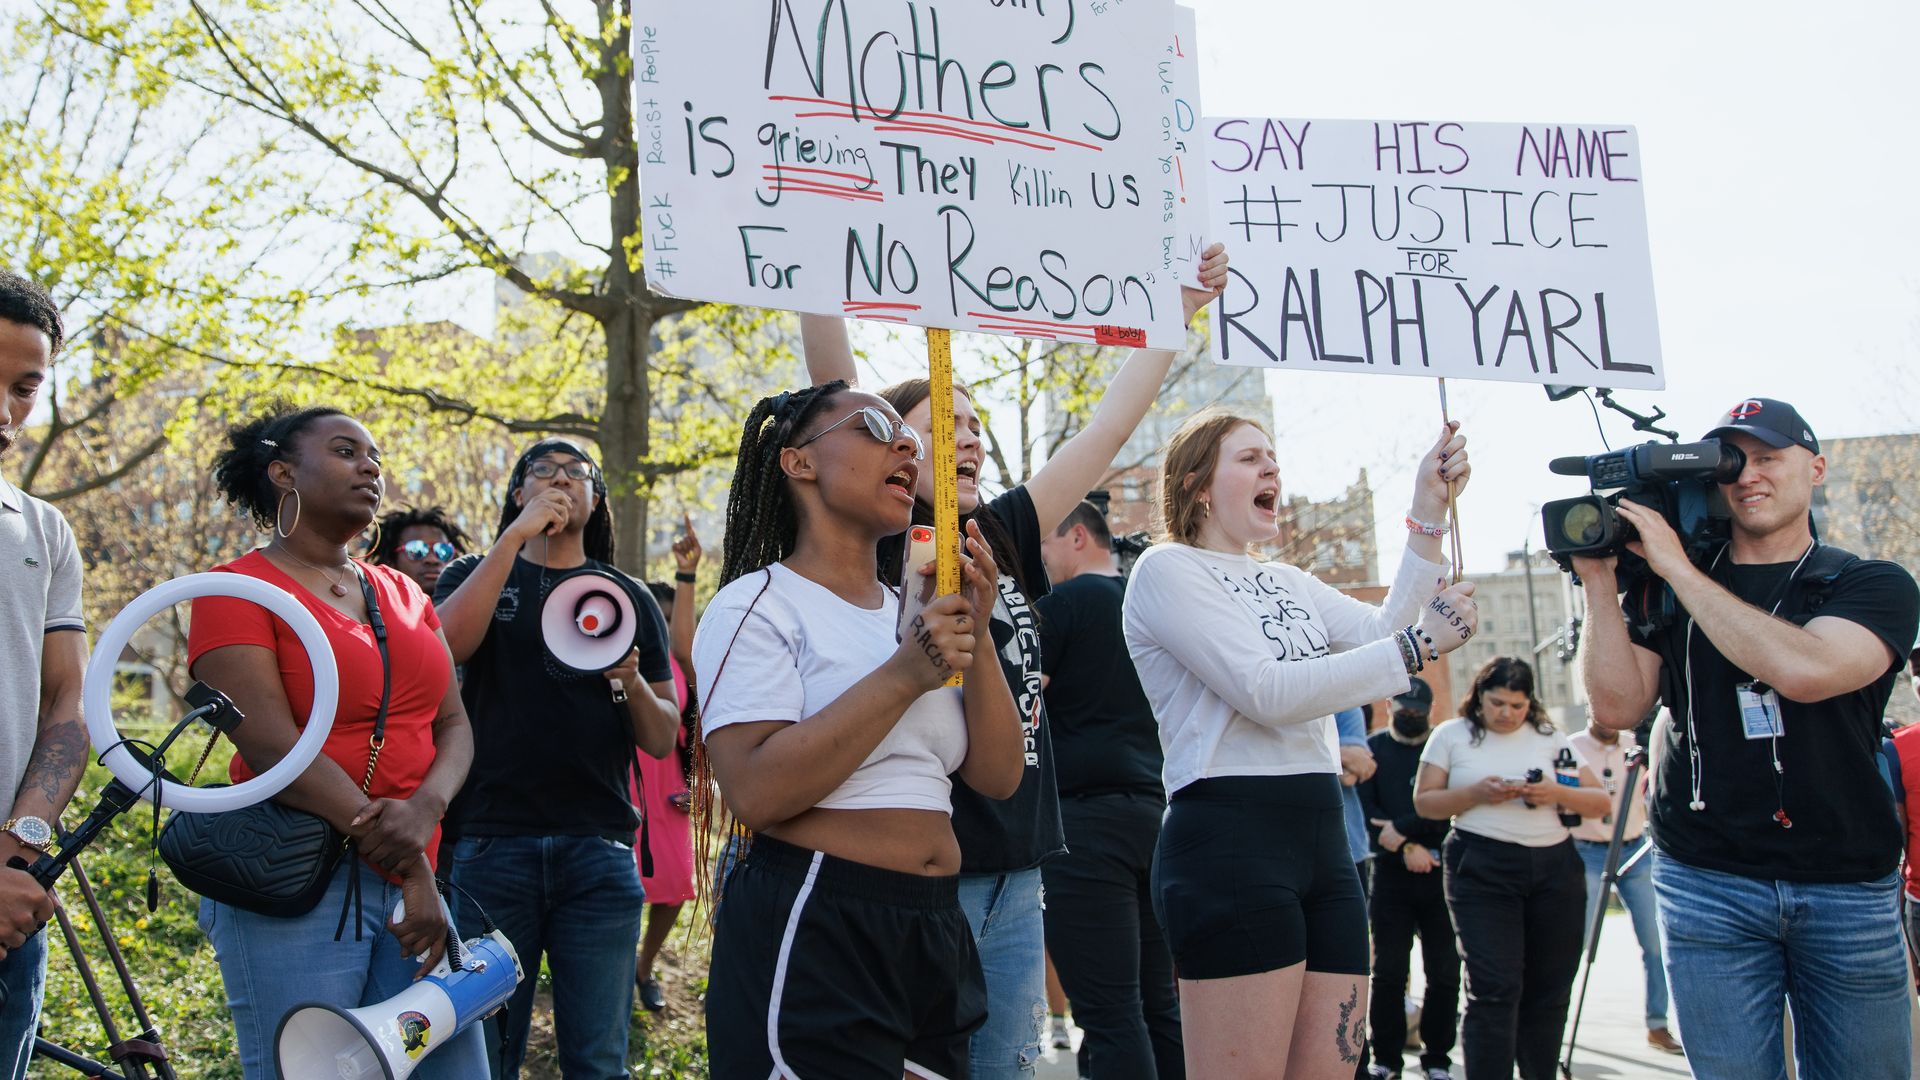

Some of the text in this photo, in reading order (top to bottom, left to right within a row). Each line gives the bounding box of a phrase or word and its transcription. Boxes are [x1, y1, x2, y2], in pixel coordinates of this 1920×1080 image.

[764, 0, 1121, 141] Mothers
[684, 101, 735, 178] is
[1161, 116, 1171, 141] on
[1211, 118, 1639, 182] SAY HIS NAME
[738, 225, 802, 290] For
[1407, 252, 1455, 274] FOR
[1219, 266, 1655, 375] RALPH YARL
[1428, 596, 1472, 640] RACISTS
